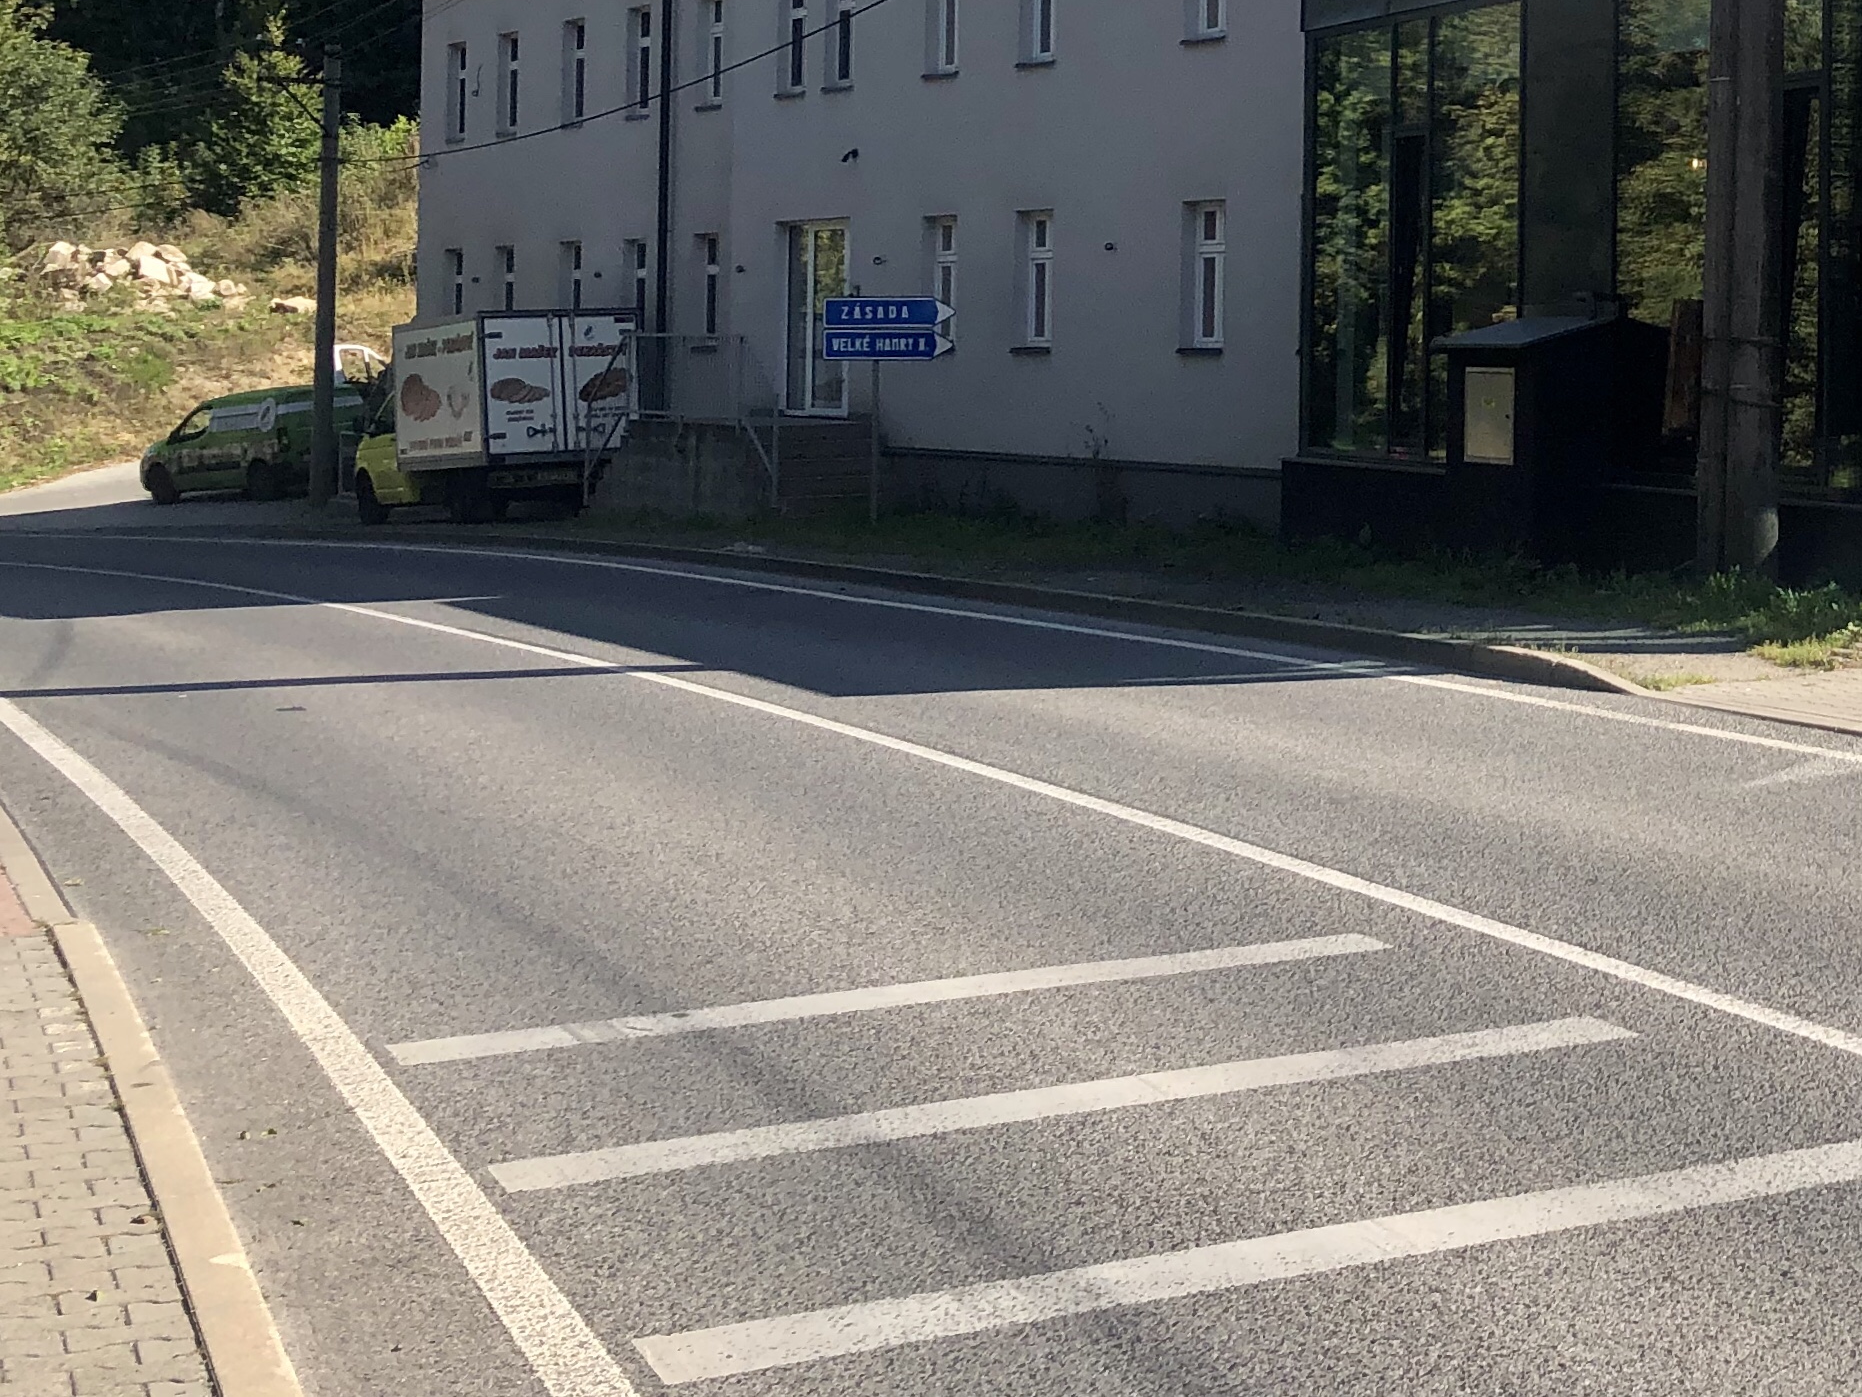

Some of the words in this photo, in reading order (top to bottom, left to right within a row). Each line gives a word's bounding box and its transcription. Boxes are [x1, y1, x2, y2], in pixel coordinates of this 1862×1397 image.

[840, 302, 910, 320] ZÁSADA
[831, 334, 870, 351] VELKÉ
[875, 337, 914, 351] HAMRY
